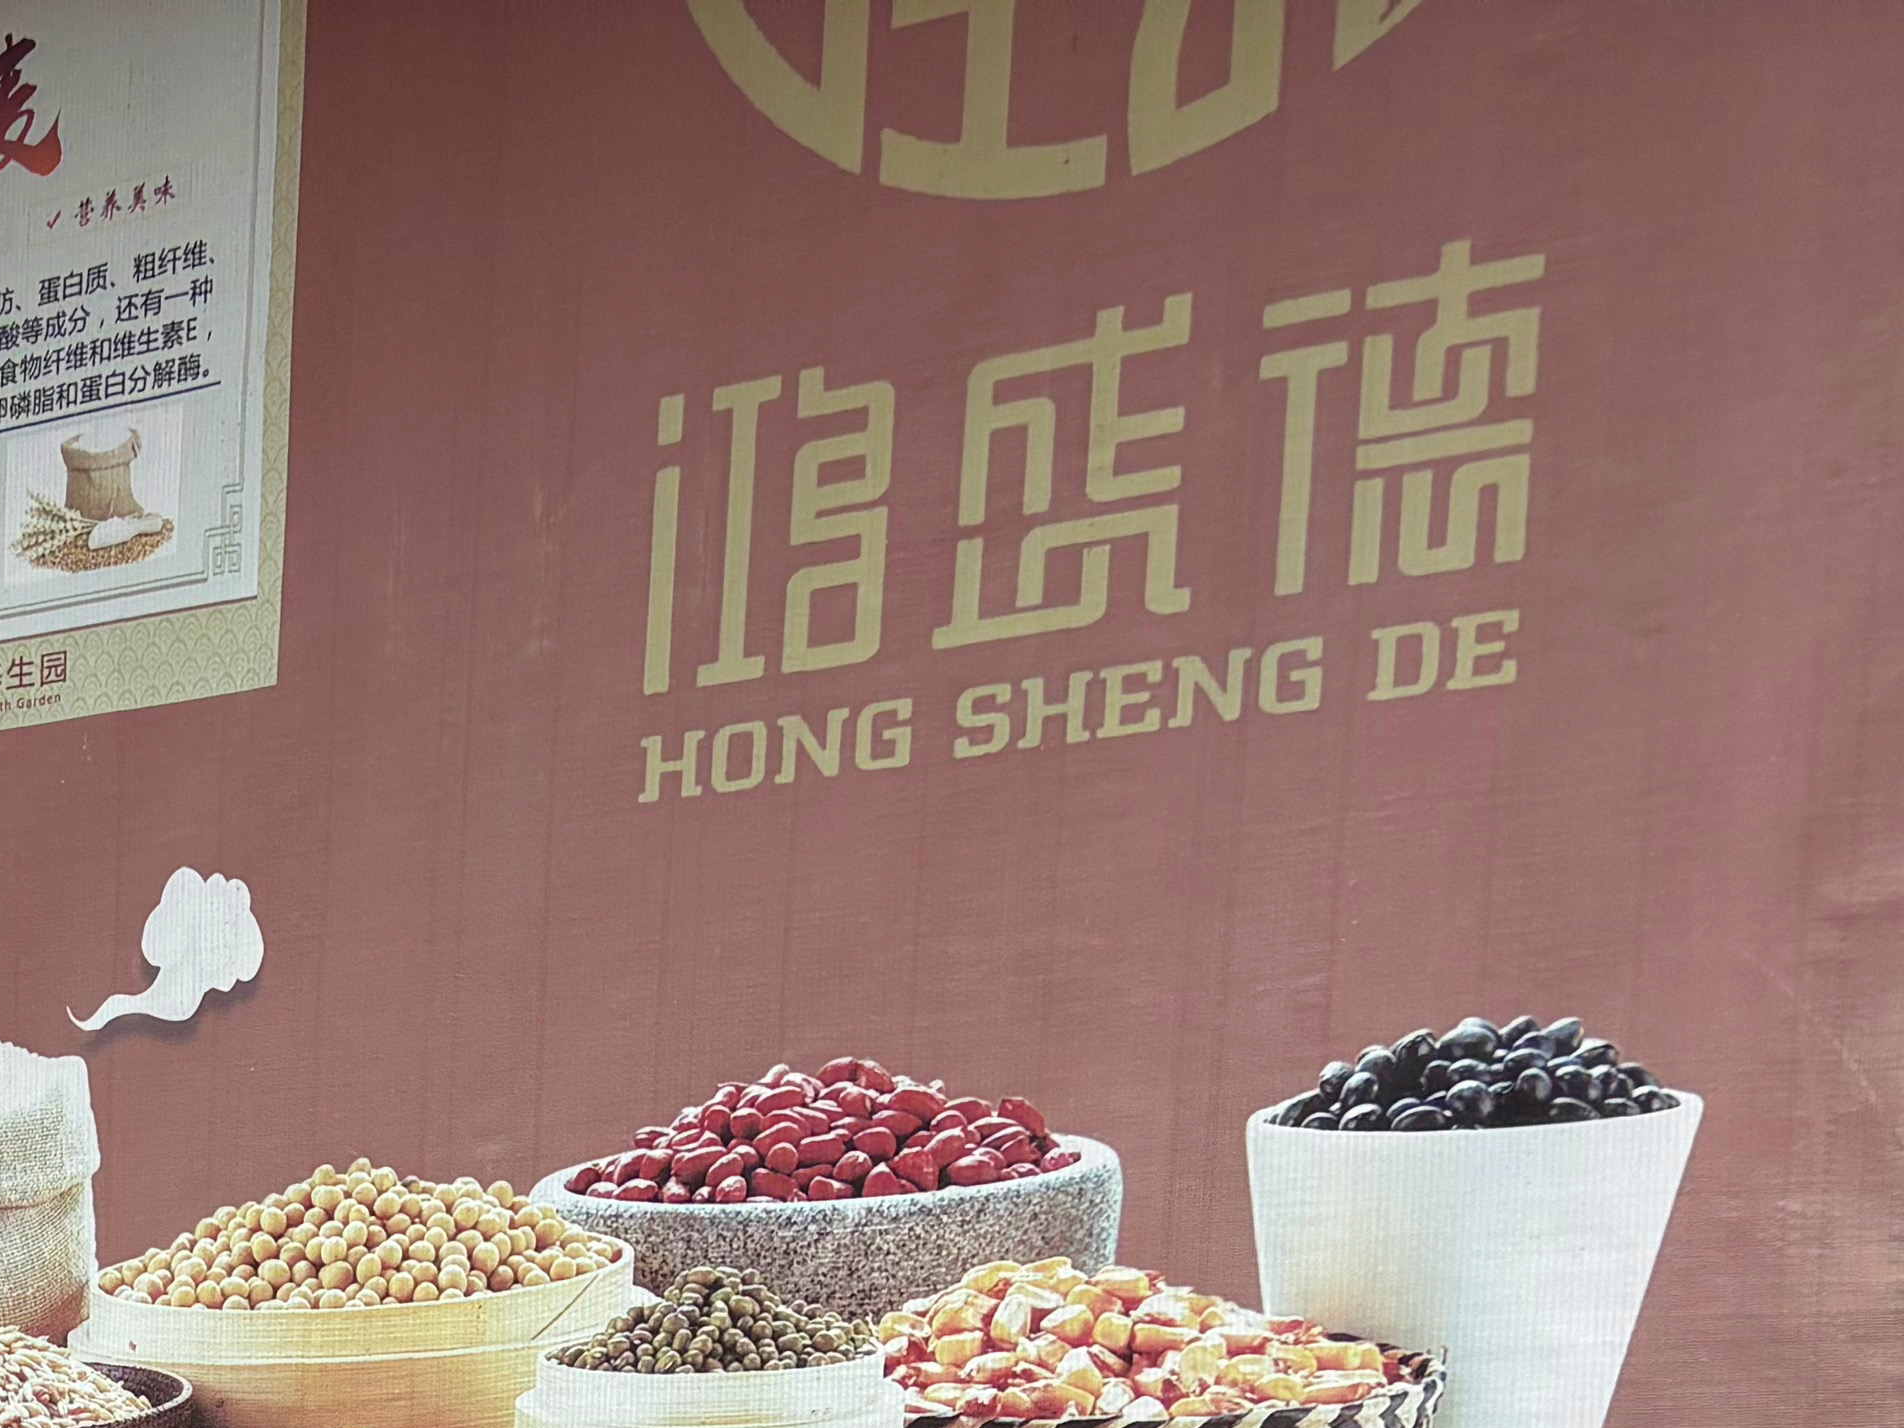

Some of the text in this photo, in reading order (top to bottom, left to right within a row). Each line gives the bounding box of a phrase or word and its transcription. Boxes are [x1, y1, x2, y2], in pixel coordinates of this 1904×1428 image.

[74, 174, 178, 229] 营养美味
[16, 693, 61, 710] Garden
[638, 608, 1520, 802] HONG SHENG DE
